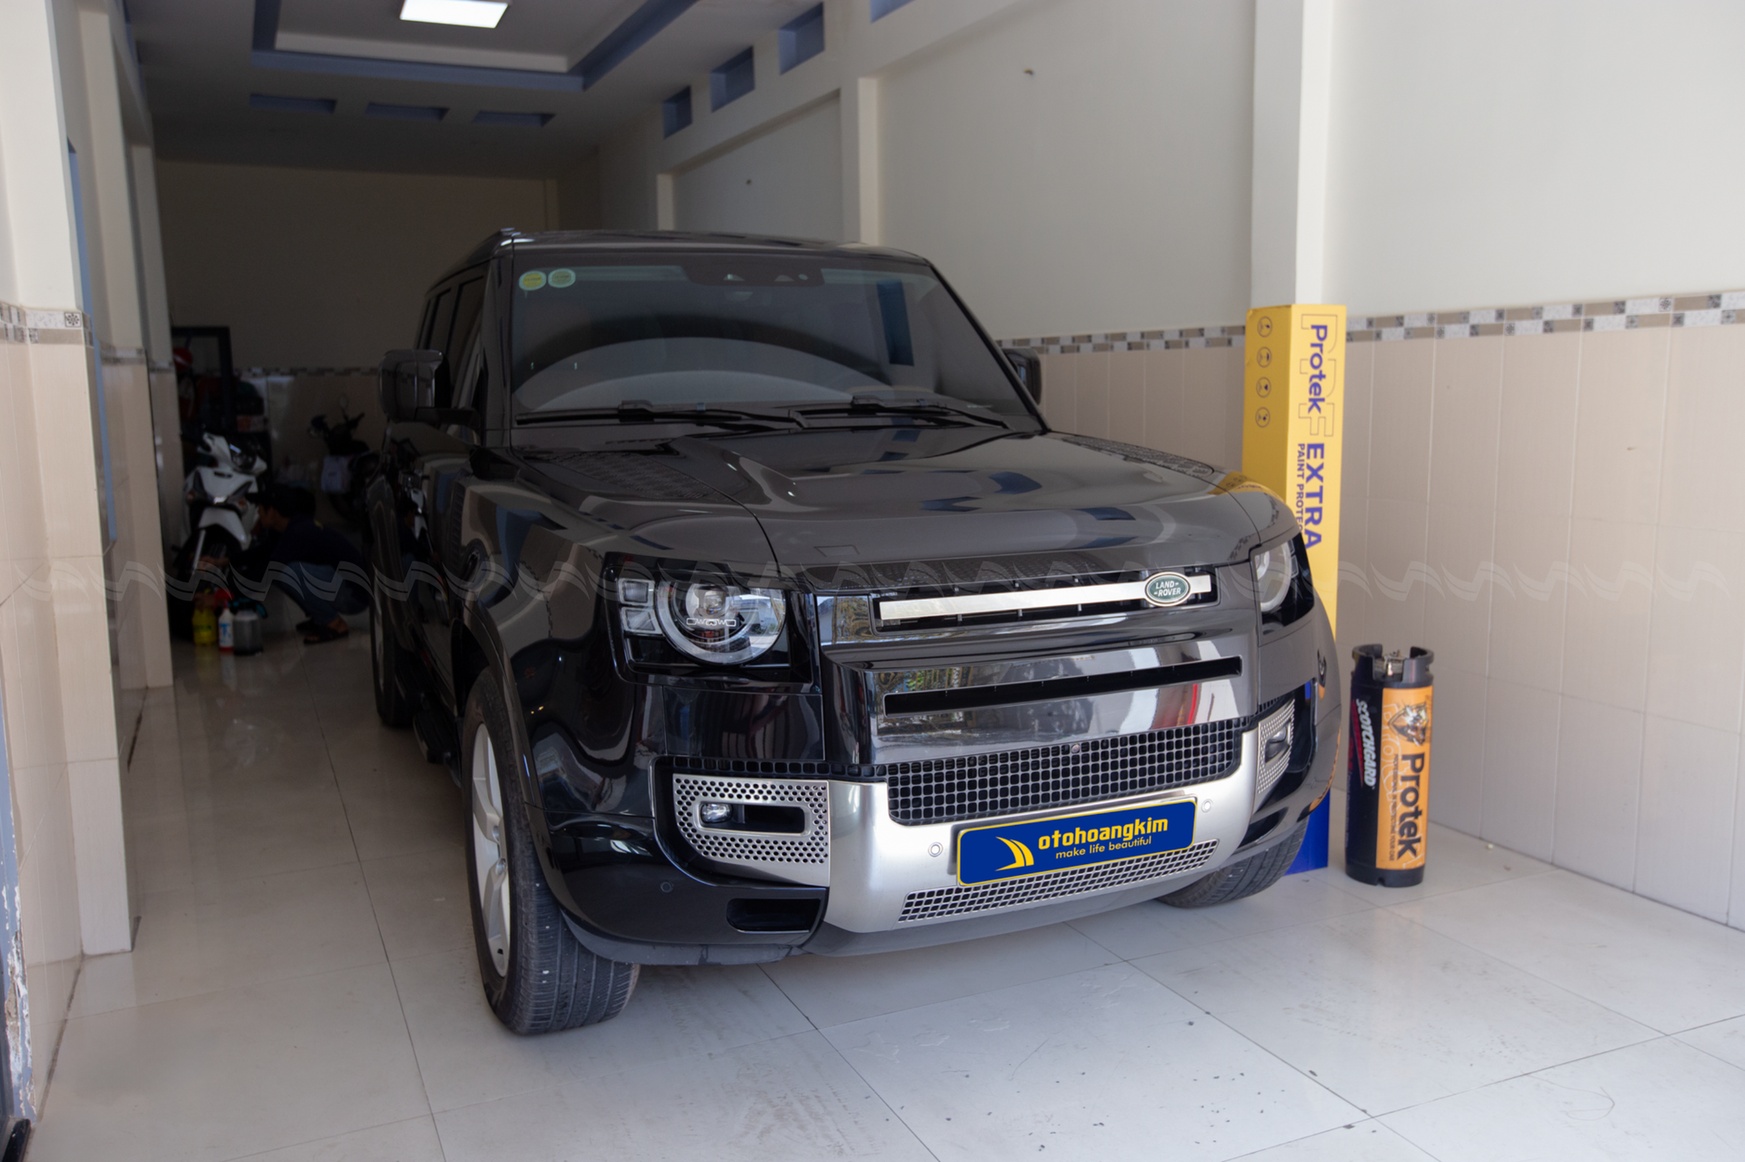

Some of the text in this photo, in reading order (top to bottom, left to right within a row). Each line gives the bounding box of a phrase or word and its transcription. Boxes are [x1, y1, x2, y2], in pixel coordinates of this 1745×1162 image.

[1308, 324, 1328, 414] Protek
[1297, 443, 1305, 479] PAINT
[1304, 443, 1325, 549] EXTRA
[1355, 698, 1377, 787] SCOTCHGARD
[1038, 817, 1168, 850] otohoangkim
[1055, 836, 1152, 860] make life beautiful
[1397, 752, 1425, 860] Protek
